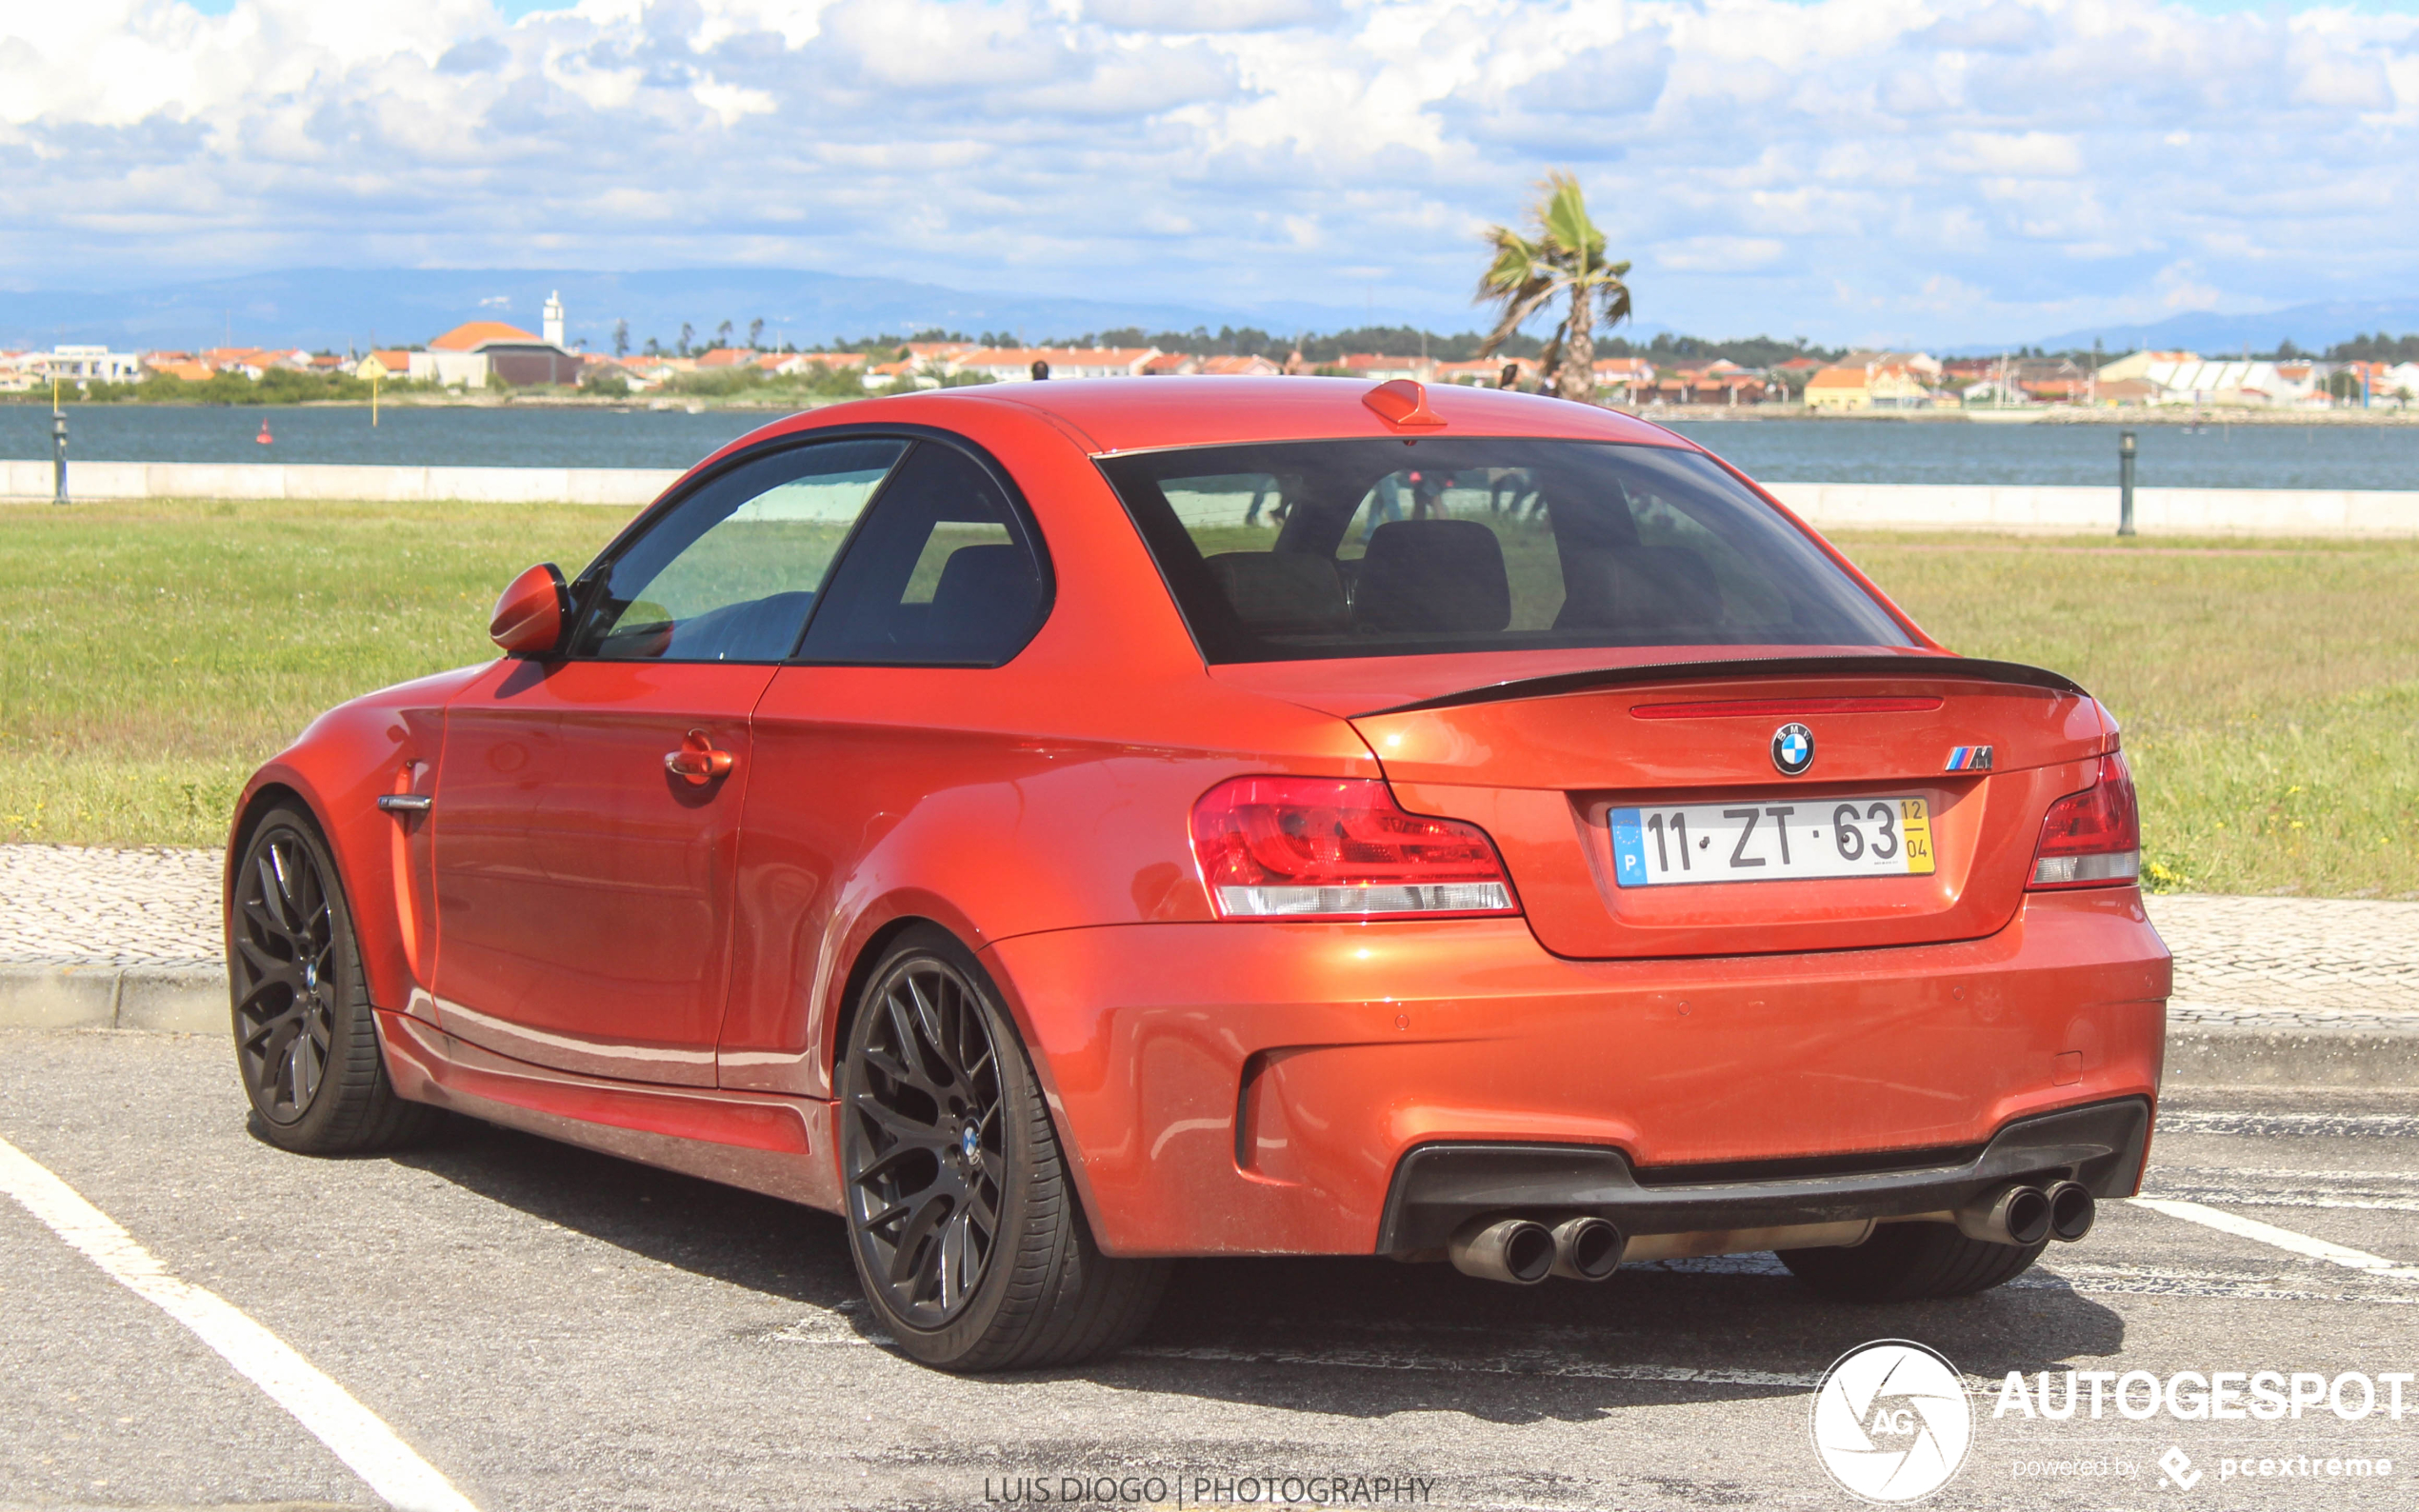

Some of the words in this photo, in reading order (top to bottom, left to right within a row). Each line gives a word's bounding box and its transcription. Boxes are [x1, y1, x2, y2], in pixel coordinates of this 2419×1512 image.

[1777, 725, 1811, 742] BMW
[1968, 746, 1992, 769] M
[1901, 801, 1923, 820] 12
[1907, 839, 1928, 858] 04
[1624, 854, 1637, 871] P
